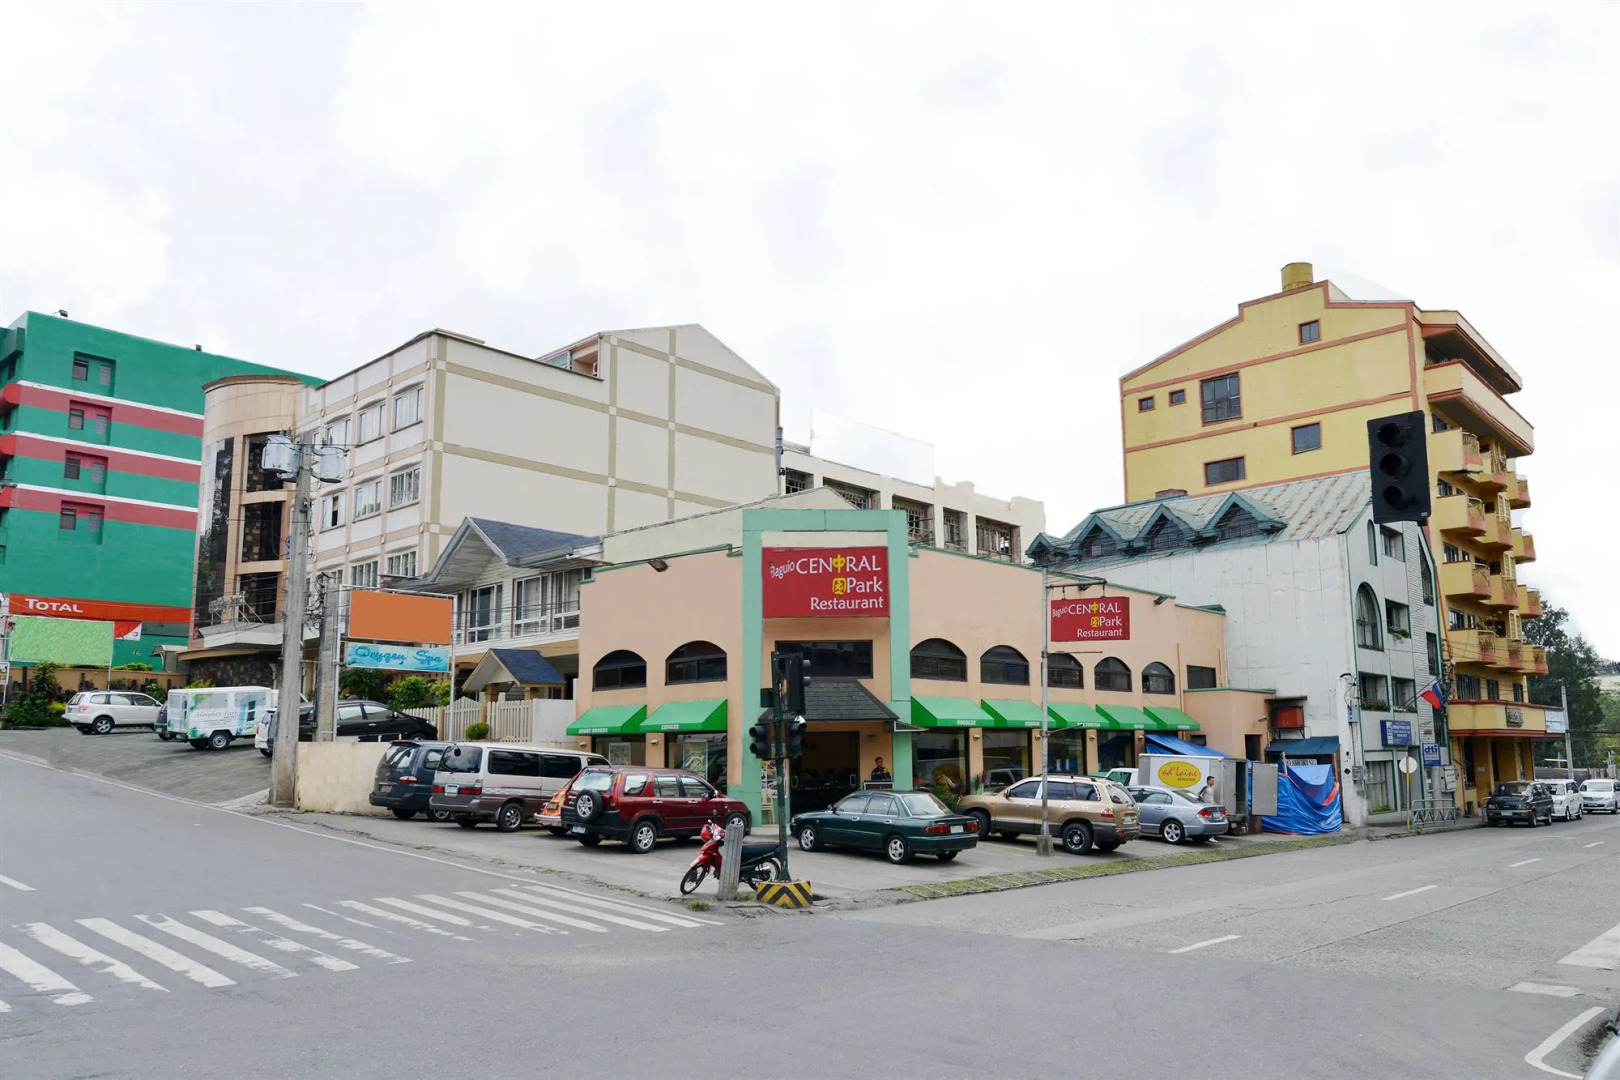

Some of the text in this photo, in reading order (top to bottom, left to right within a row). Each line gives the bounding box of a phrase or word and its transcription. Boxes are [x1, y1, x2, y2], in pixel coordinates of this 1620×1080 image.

[769, 560, 795, 579] Baguio
[847, 576, 883, 593] Park
[25, 598, 83, 613] TOTAL
[810, 597, 884, 611] Restaurant
[1099, 615, 1123, 627] Park
[1077, 628, 1123, 638] Restaurant
[413, 649, 443, 665] Spa
[1424, 745, 1438, 753] dti
